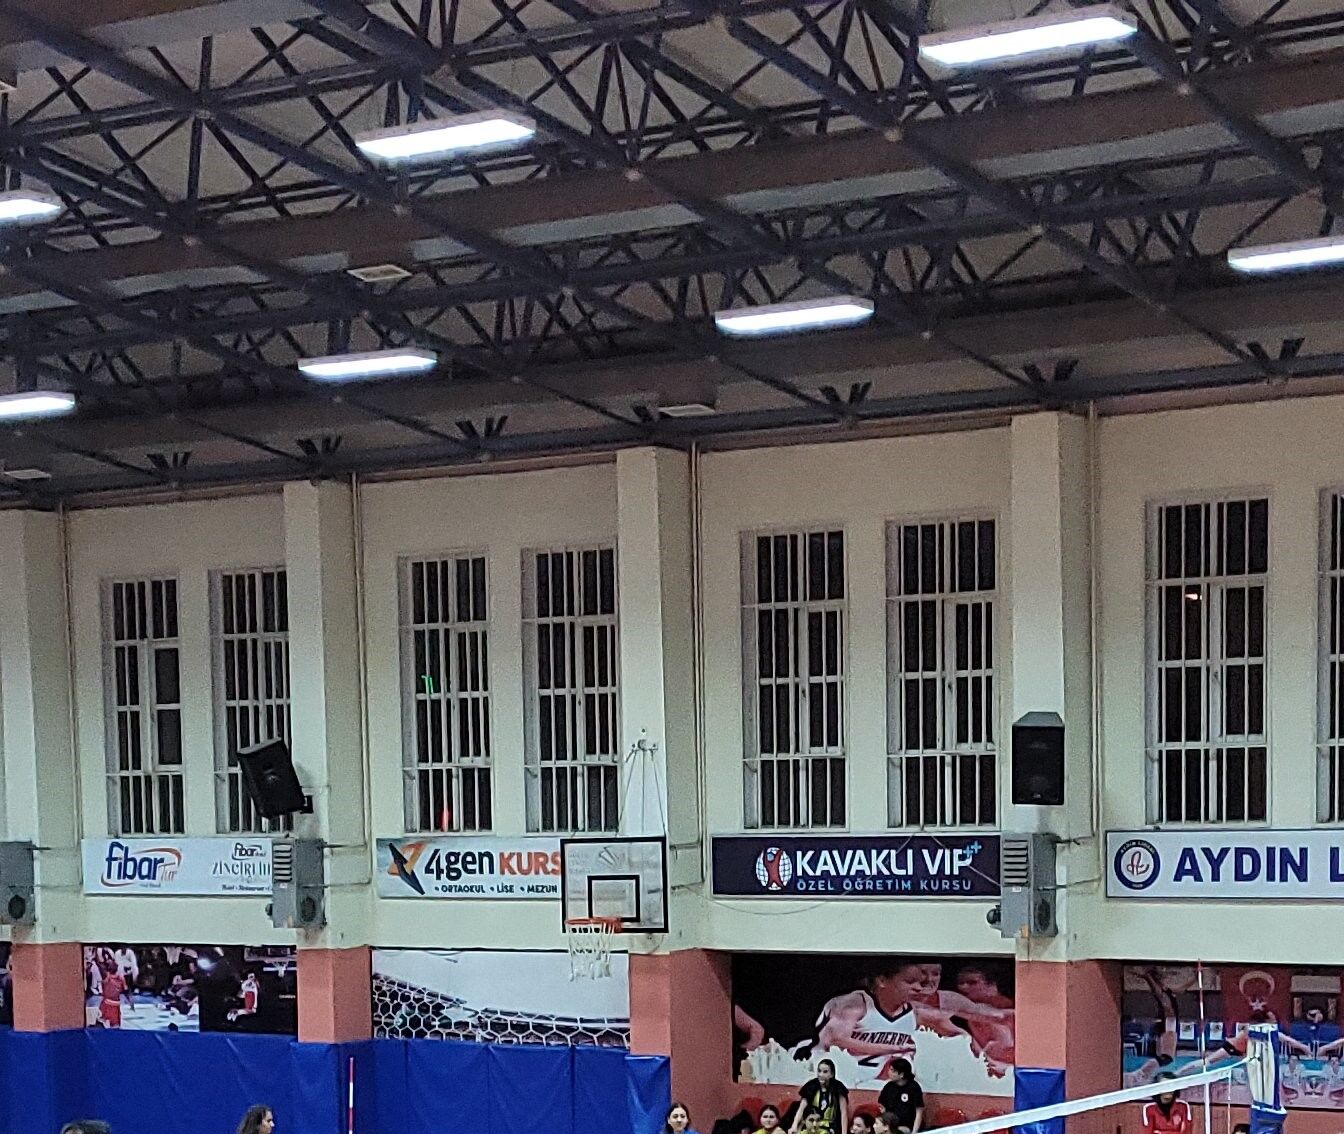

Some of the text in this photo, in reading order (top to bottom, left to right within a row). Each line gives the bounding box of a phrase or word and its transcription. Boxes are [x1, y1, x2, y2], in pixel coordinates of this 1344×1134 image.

[424, 848, 495, 881] 4gen
[796, 848, 914, 876] KAVAKLI
[1172, 845, 1310, 883] AYDIN
[796, 877, 973, 892] ÖZEL ÖĞRETİM KURSU
